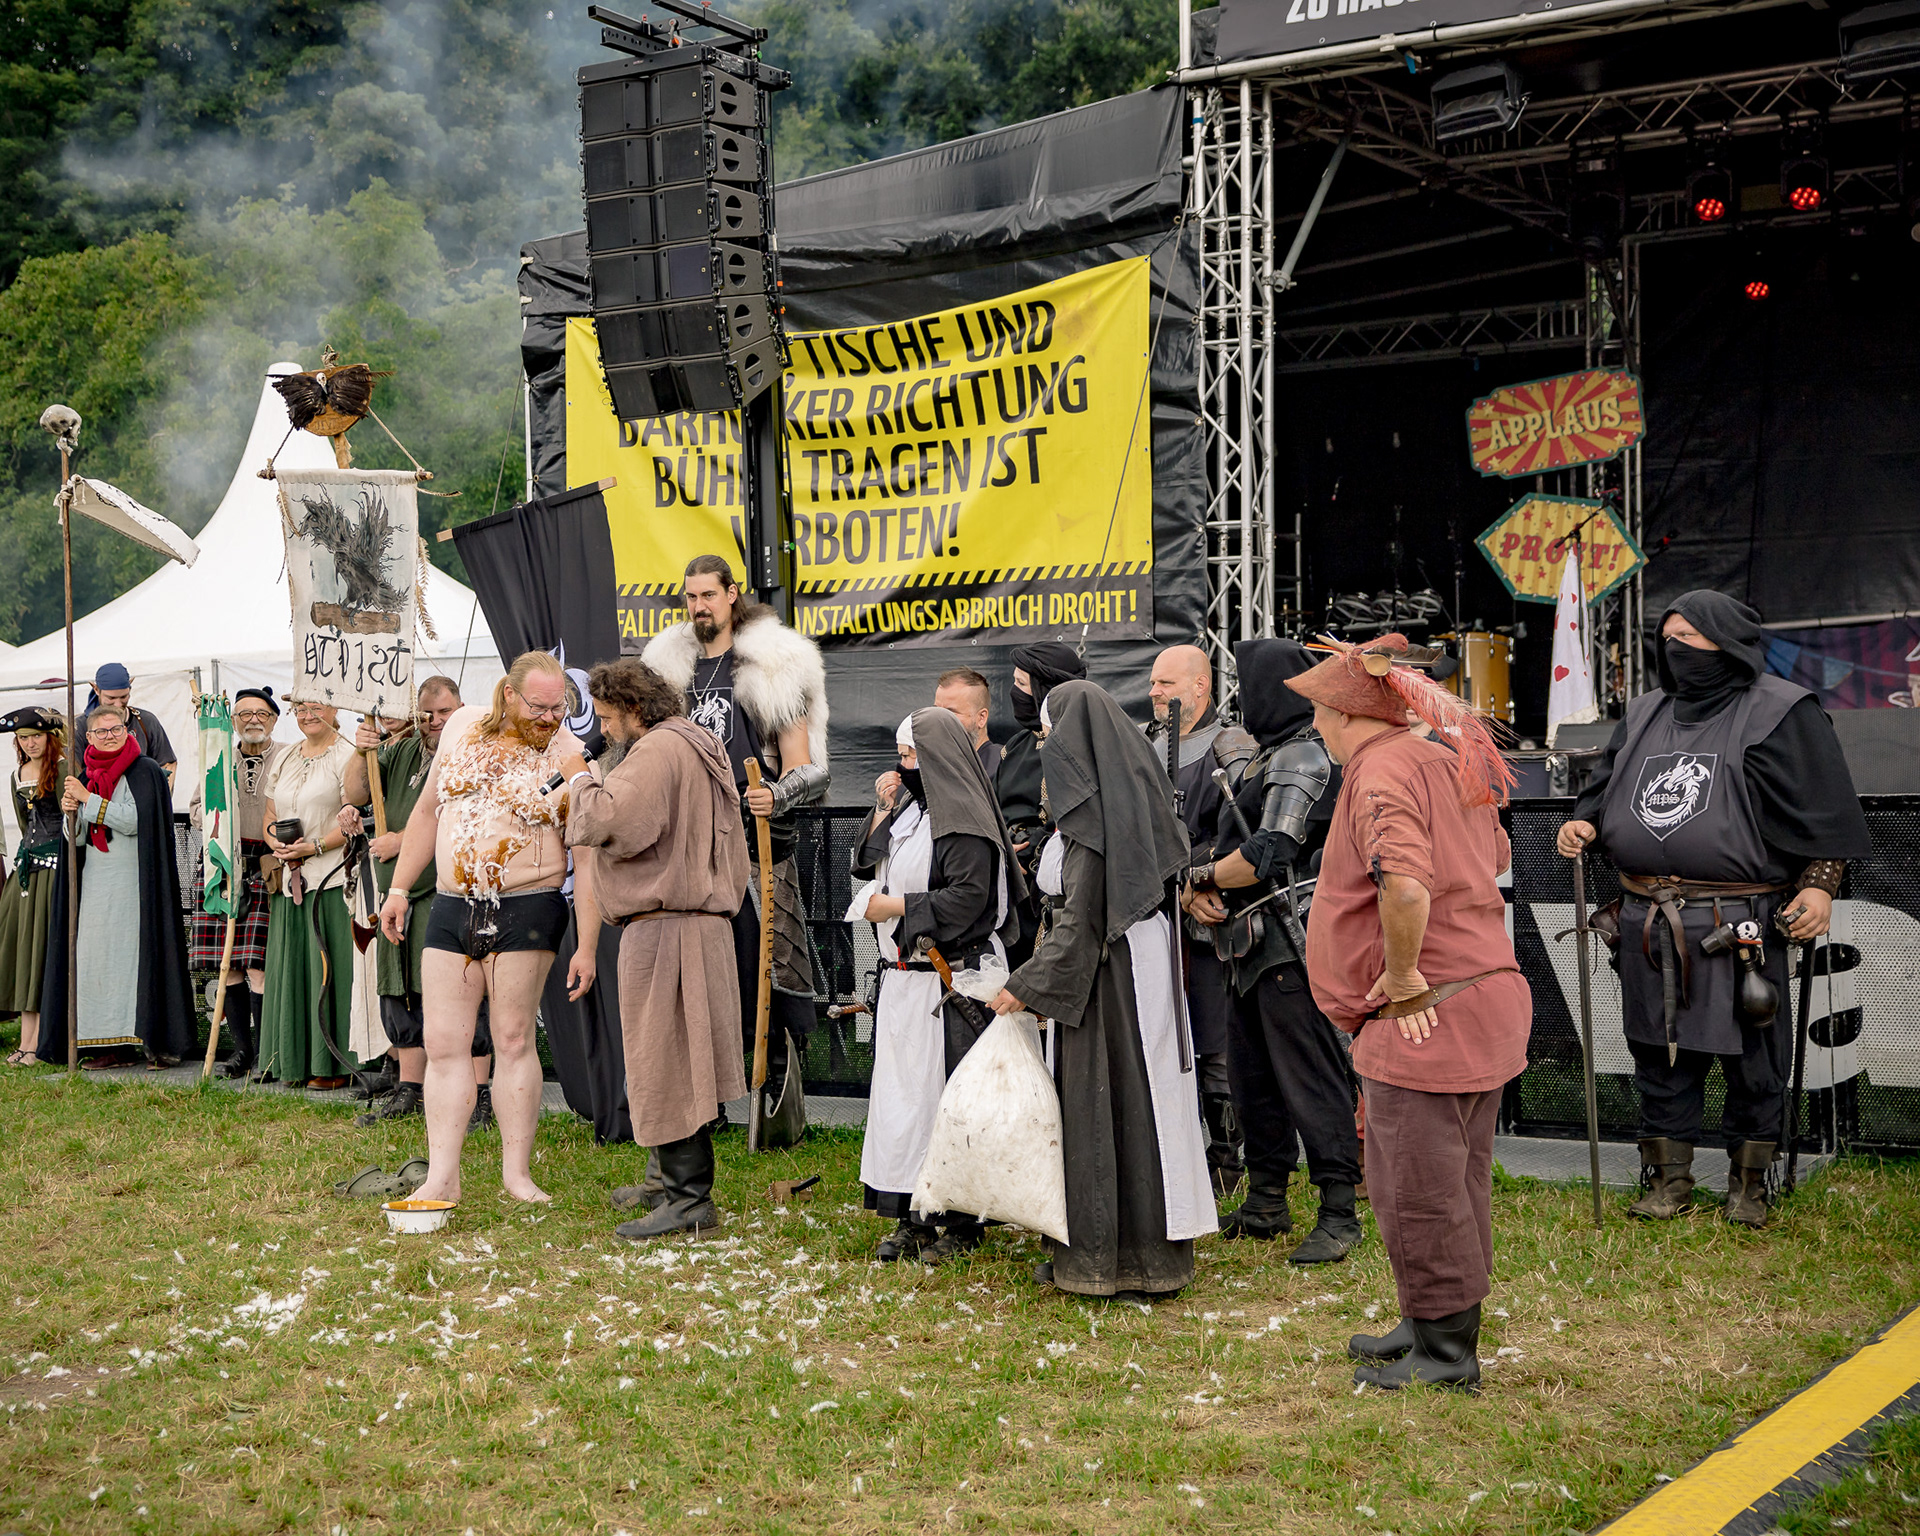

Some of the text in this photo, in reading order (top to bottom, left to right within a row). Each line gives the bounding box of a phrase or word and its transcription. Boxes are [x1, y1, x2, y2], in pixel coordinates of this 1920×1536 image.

[793, 300, 1057, 380] TISCHE UND
[866, 355, 1089, 436] RICHTUNG
[1488, 396, 1622, 450] APPLAUS
[802, 437, 971, 503] TRAGEN
[978, 427, 1048, 489] IST
[1647, 793, 1681, 807] MPS
